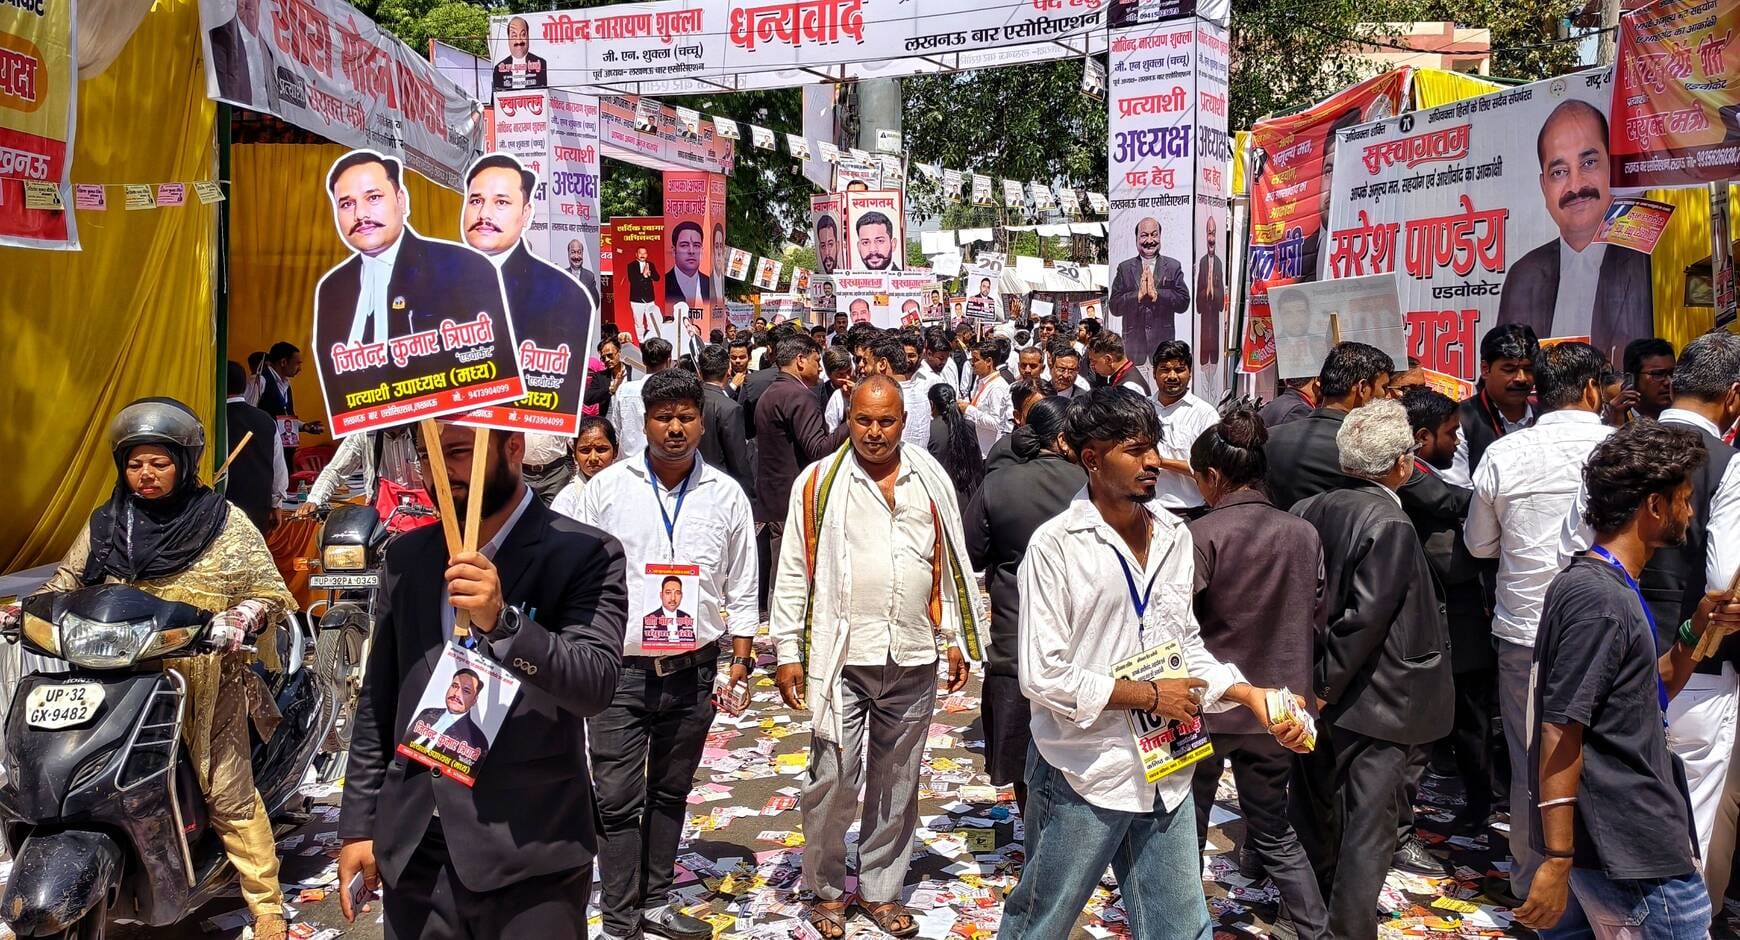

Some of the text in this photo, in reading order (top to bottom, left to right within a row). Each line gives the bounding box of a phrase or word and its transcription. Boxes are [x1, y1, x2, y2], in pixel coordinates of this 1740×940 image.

[542, 8, 703, 44] गोविन्द नारायण शुक्ला
[729, 0, 864, 52] धन्यवाद
[904, 12, 1100, 51] लखनऊ बार एसोसिएशन
[1139, 35, 1167, 49] नारायण
[1170, 31, 1192, 49] शुक्ला
[643, 47, 671, 63] शुक्ला
[1142, 58, 1164, 72] शुक्ला
[1118, 86, 1186, 119] प्रत्याशी
[1113, 125, 1191, 163] अध्यक्ष
[554, 145, 595, 163] प्रत्याशी
[1126, 166, 1175, 189] पद हेतु
[1465, 166, 1474, 182] का
[552, 171, 598, 198] अध्यक्ष
[813, 201, 838, 215] स्वागतम्
[852, 198, 896, 210] स्वागतम्
[1111, 193, 1190, 209] लखनऊ बार एसोसिएशन
[560, 202, 590, 220] पद हेतु
[1404, 194, 1509, 280] पाण्डेय
[1432, 280, 1501, 298] एडवोकेट
[332, 312, 494, 374] जितेन्द्र कुमार त्रिपाठी
[520, 340, 570, 375] त्रिपाठी
[346, 361, 497, 408] प्रत्याशी उपाध्यक्ष (मध्य)
[468, 384, 509, 400] 9473904099
[523, 415, 564, 427] 9473904099
